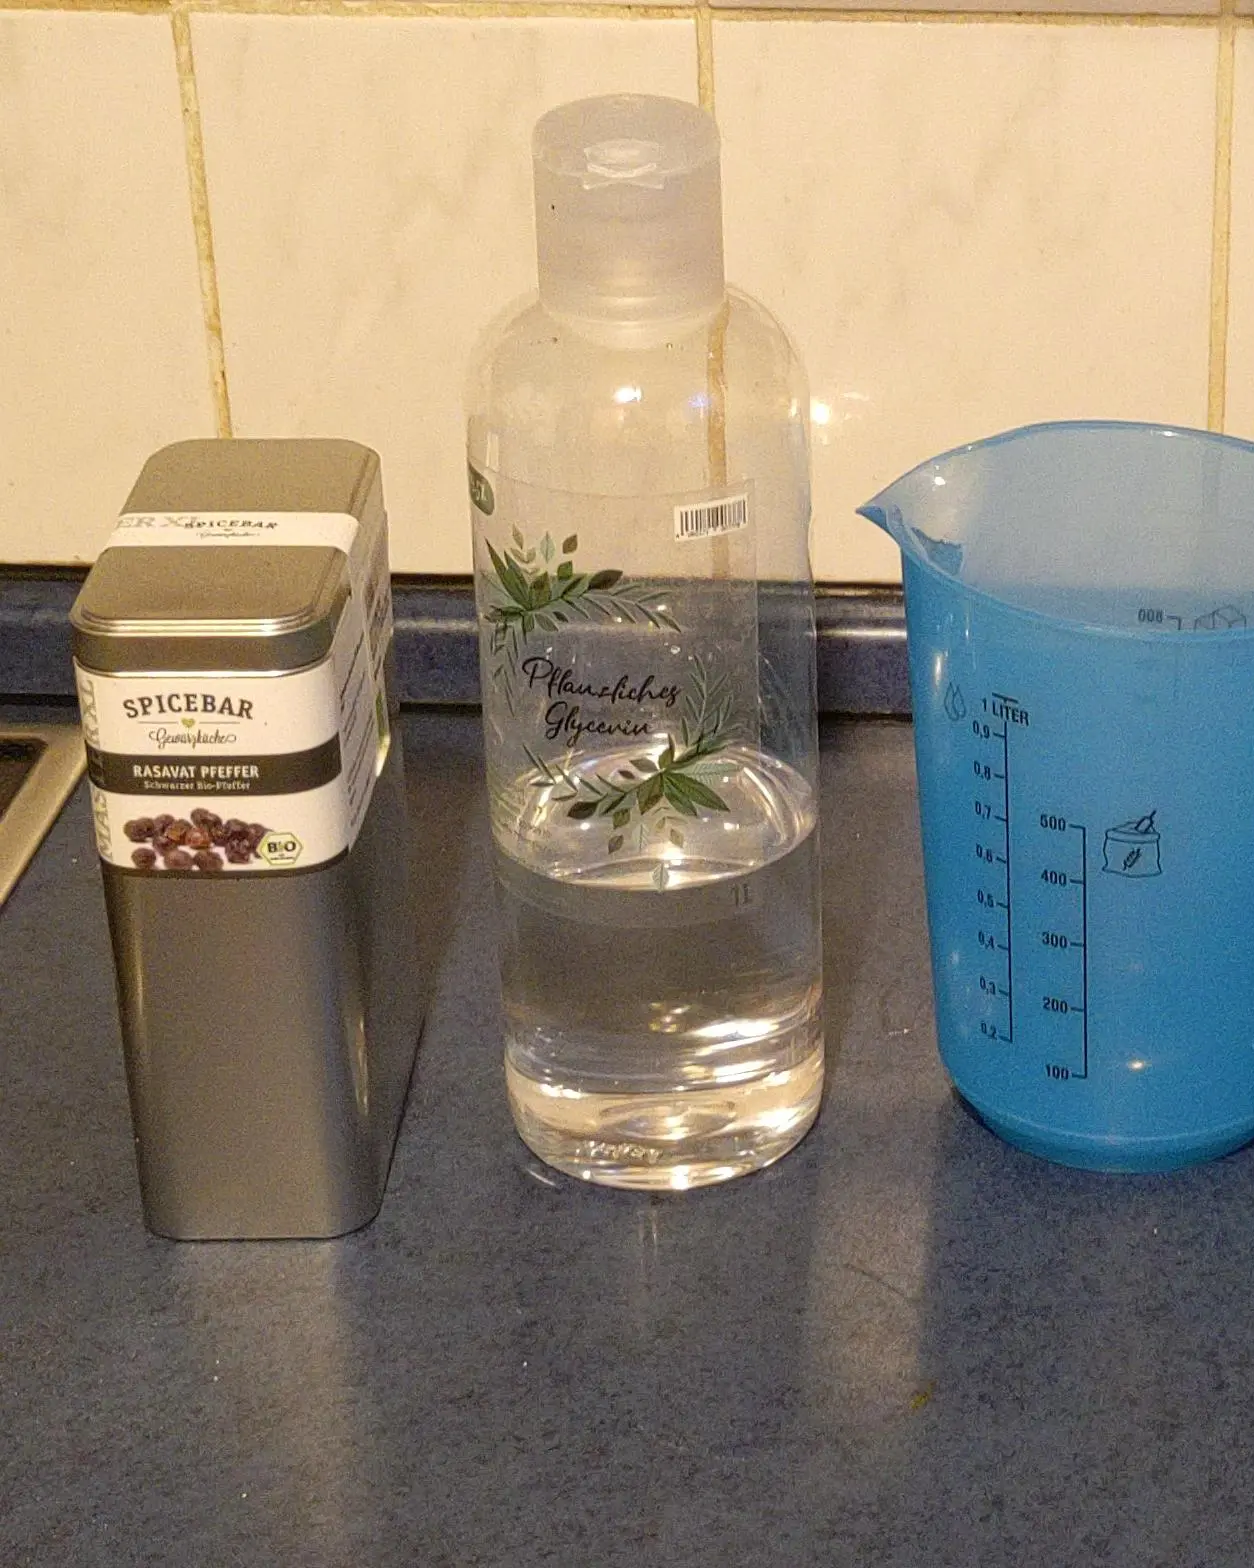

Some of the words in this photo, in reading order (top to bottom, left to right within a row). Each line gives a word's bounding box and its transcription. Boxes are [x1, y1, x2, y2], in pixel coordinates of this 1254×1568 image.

[522, 656, 682, 708] Pflanzliches
[123, 693, 254, 720] SPICEBAR
[981, 697, 988, 712] 1
[992, 700, 1030, 727] LITER
[545, 701, 652, 748] Glycerin
[132, 764, 196, 779] RASAVAT
[200, 765, 260, 779] PFEFFER
[143, 780, 195, 791] Schwarzer
[1040, 813, 1067, 832] 500
[1040, 868, 1068, 887] 400
[1041, 930, 1069, 950] 300
[1042, 996, 1070, 1015] 200
[1045, 1063, 1070, 1081] 100
